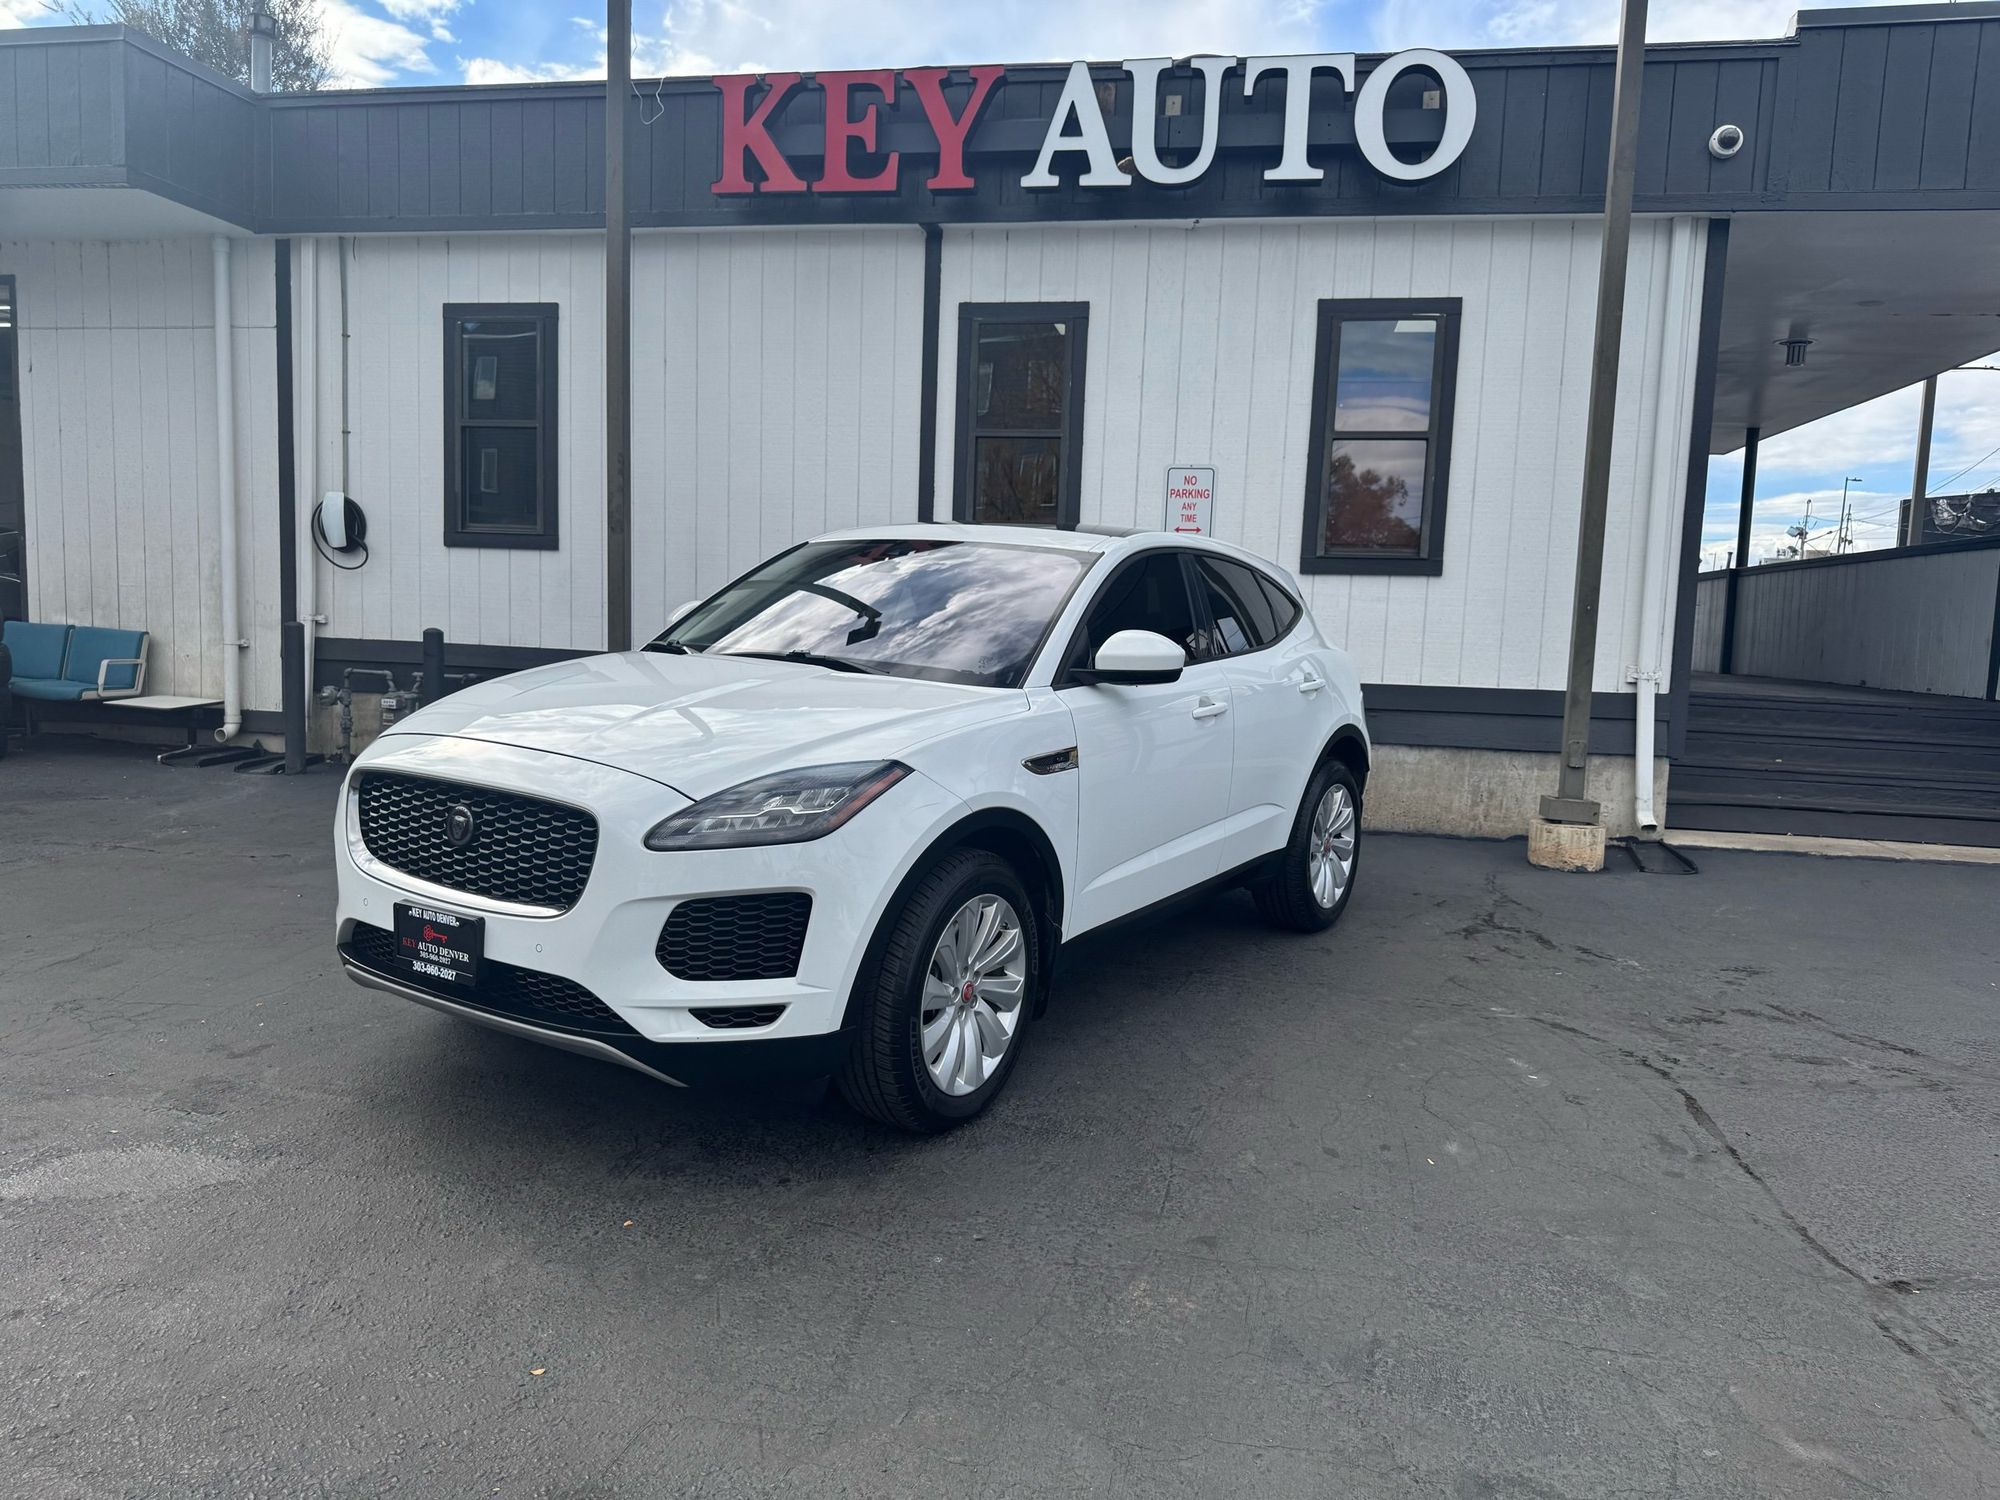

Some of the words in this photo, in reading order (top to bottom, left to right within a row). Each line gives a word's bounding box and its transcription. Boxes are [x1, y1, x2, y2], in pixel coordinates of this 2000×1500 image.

[711, 64, 1005, 193] KEY
[1020, 48, 1477, 186] AUTO
[1184, 475, 1197, 485] NO
[1170, 488, 1210, 499] PARKING
[1182, 502, 1197, 511] ANY
[1181, 513, 1197, 523] TIME
[411, 907, 422, 918] KEY
[423, 910, 436, 921] AUTO
[437, 913, 456, 926] DENVER
[403, 937, 416, 947] KEY
[418, 941, 438, 953] AUTO
[440, 947, 469, 962] DENVER
[412, 961, 456, 981] 303-960-2027
